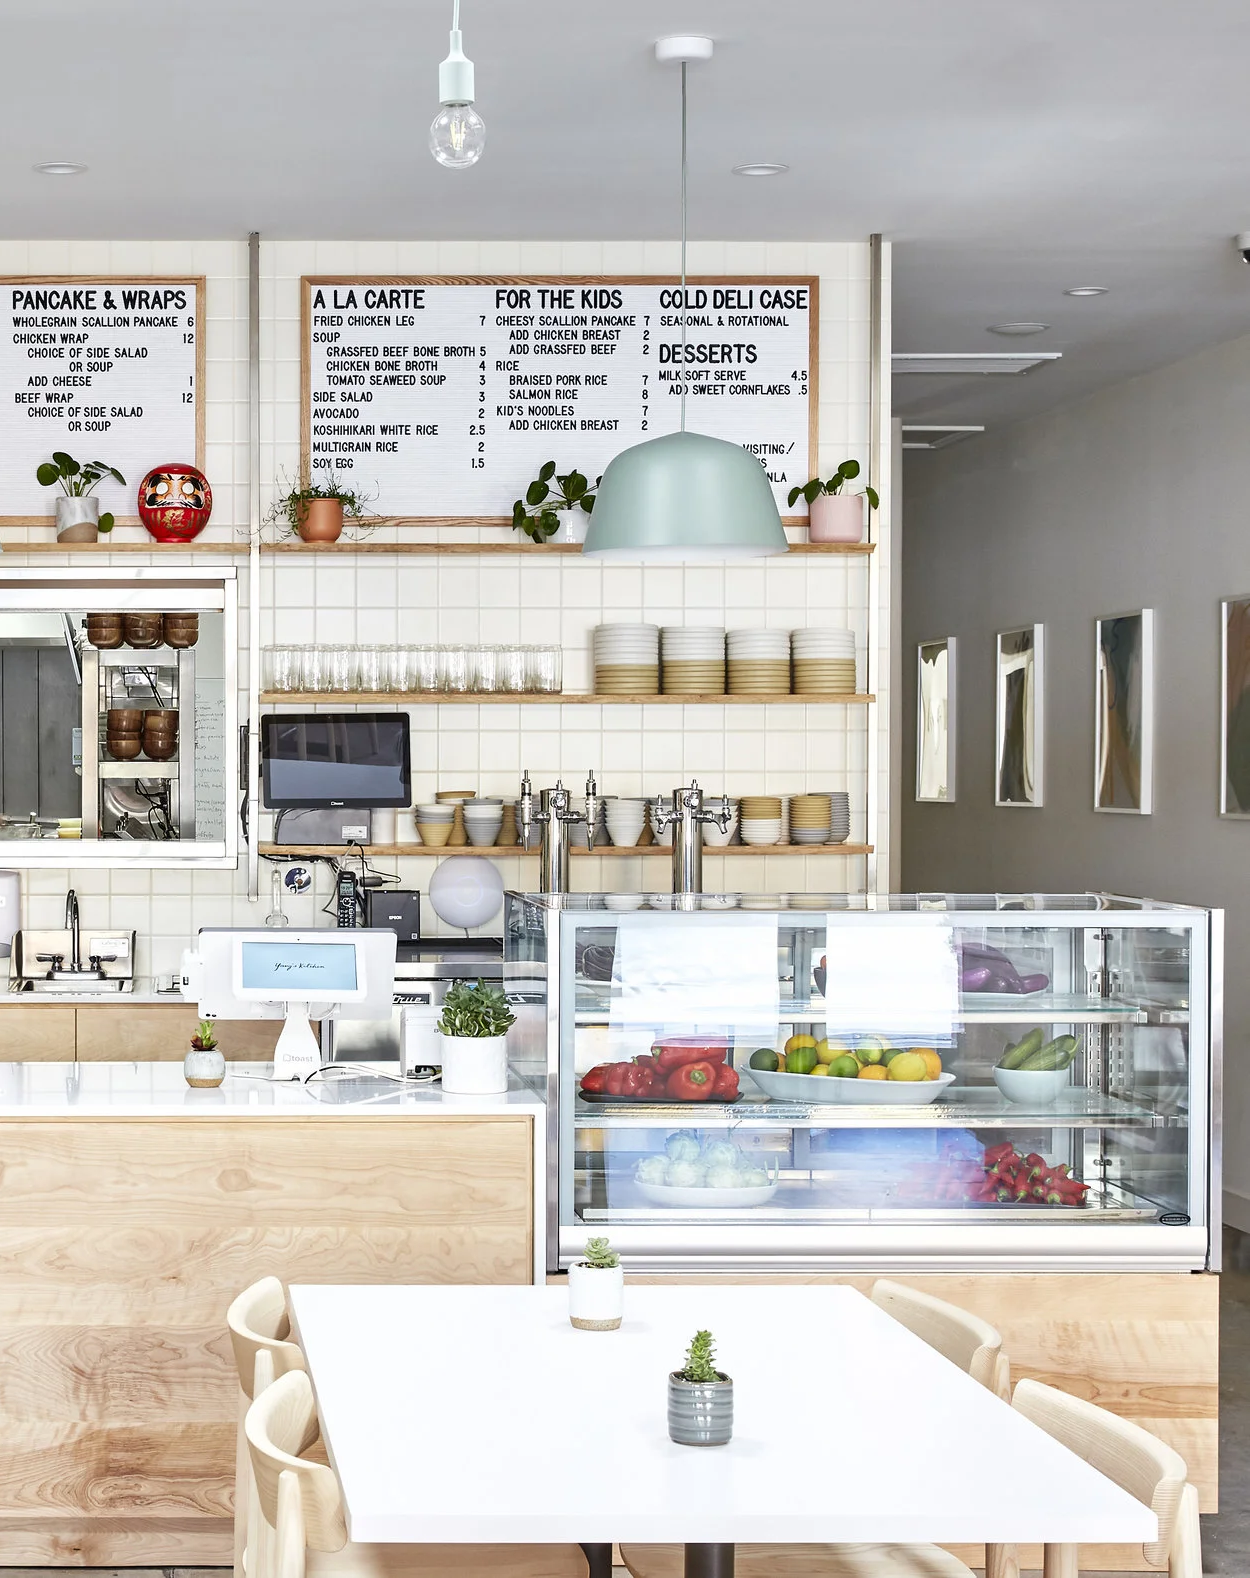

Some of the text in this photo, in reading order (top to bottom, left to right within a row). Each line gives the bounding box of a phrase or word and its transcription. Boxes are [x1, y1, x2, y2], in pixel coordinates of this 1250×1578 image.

[12, 289, 187, 311] PANCAKE & WRAPS
[312, 289, 426, 310] A LA CARTE
[495, 288, 623, 310] FOR THE KIDS
[659, 289, 808, 310] COLD DELI CASE
[12, 316, 179, 328] WHOLEGRAIN SCALLION PANCAKE
[313, 315, 415, 327] FRIED CHICKEN LEG
[495, 315, 636, 327] CHEESY SCALLION PANCAKE
[12, 332, 194, 344] CHICKEN WRAP 12
[27, 347, 148, 359] CHOICE OF SIDE SALAD
[326, 345, 476, 358] GRASSFED BEEF BONE BROTH
[508, 343, 617, 355] ADD GRASSFED BEEF
[659, 343, 758, 364] DESSERTS
[69, 361, 114, 373] OR SOUP
[326, 374, 447, 386] TOMATO SEAWEED SOUP
[658, 369, 808, 381] MILK SOFT SERVE 4.5
[312, 391, 373, 403] SIDE SALAD
[508, 388, 579, 400] SALMON RICE
[312, 407, 360, 419] AVOCADO
[496, 405, 575, 417] KID'S NOODLES
[313, 424, 486, 436] KOSHIHIKARI WHITE RICE 2.5
[312, 441, 399, 453] MULTIGRAIN RICE
[291, 1055, 313, 1063] toast
